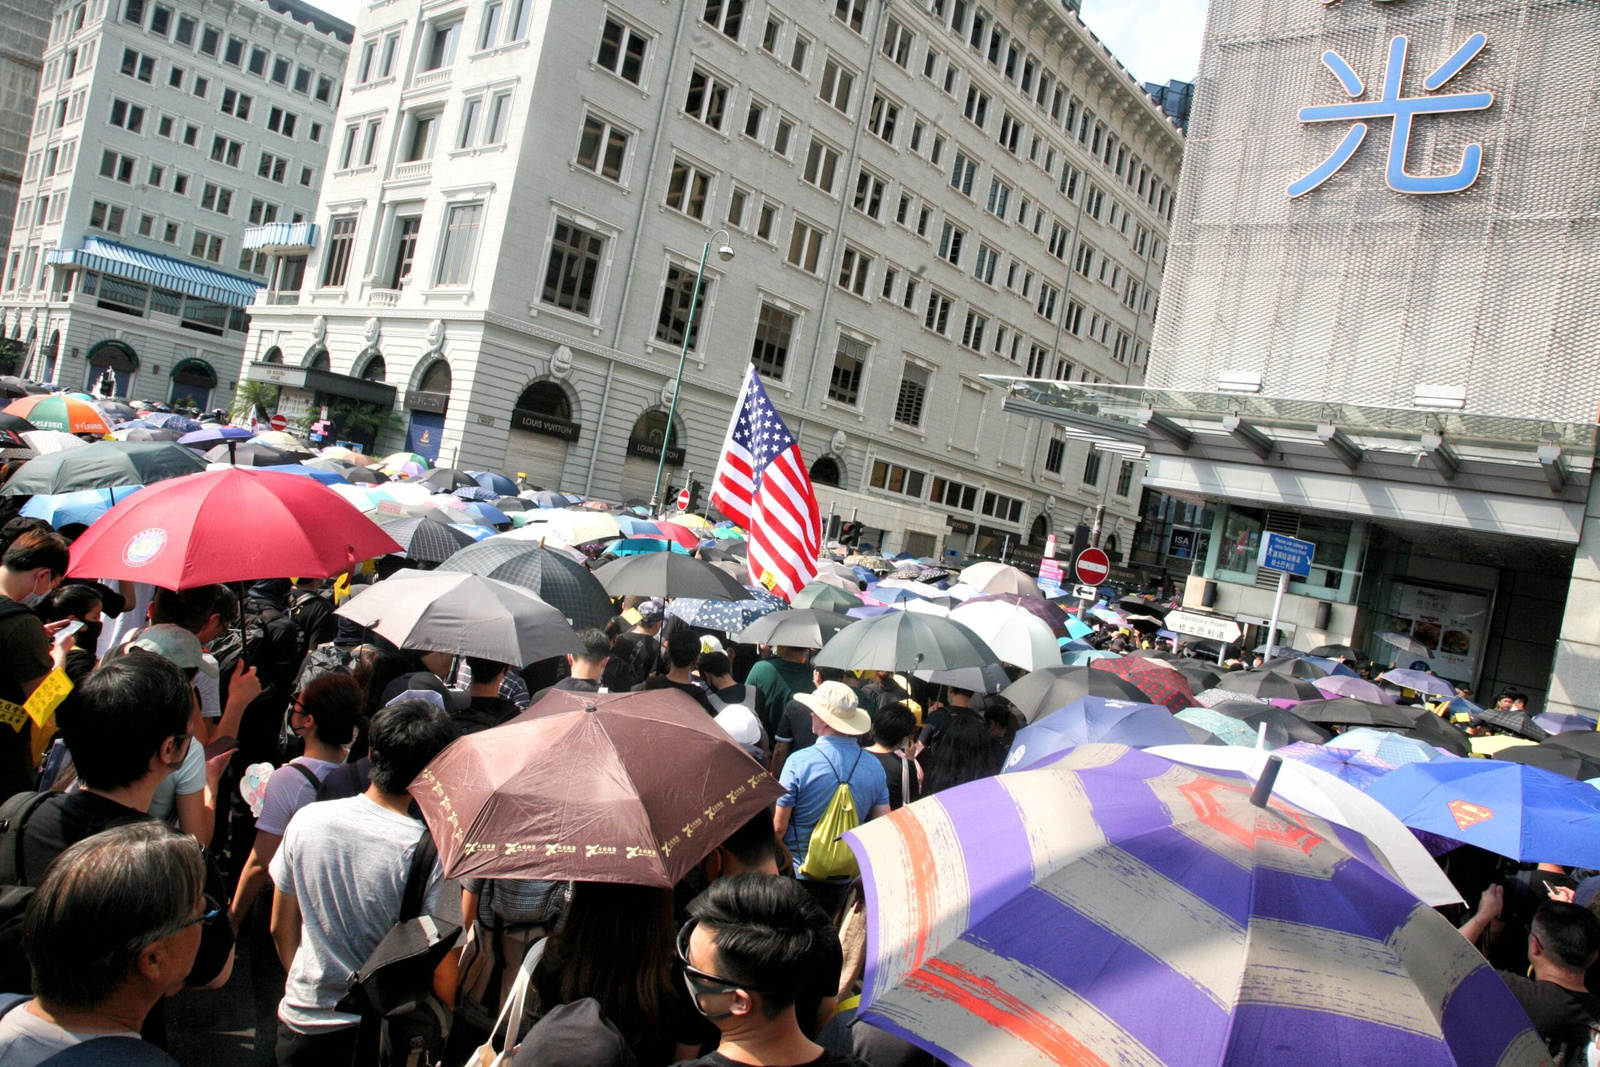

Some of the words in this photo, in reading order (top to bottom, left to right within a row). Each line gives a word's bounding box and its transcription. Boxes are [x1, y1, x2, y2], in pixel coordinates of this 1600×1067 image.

[1286, 32, 1495, 198] 光
[522, 417, 543, 429] LOUIS
[543, 421, 572, 435] VUITTON
[637, 444, 654, 454] LOUIS
[654, 447, 679, 460] VUTON
[1174, 535, 1189, 545] ISA
[1180, 614, 1208, 625] Salisbury
[1209, 619, 1227, 629] Road
[1178, 623, 1225, 639] 梳士巴利道
